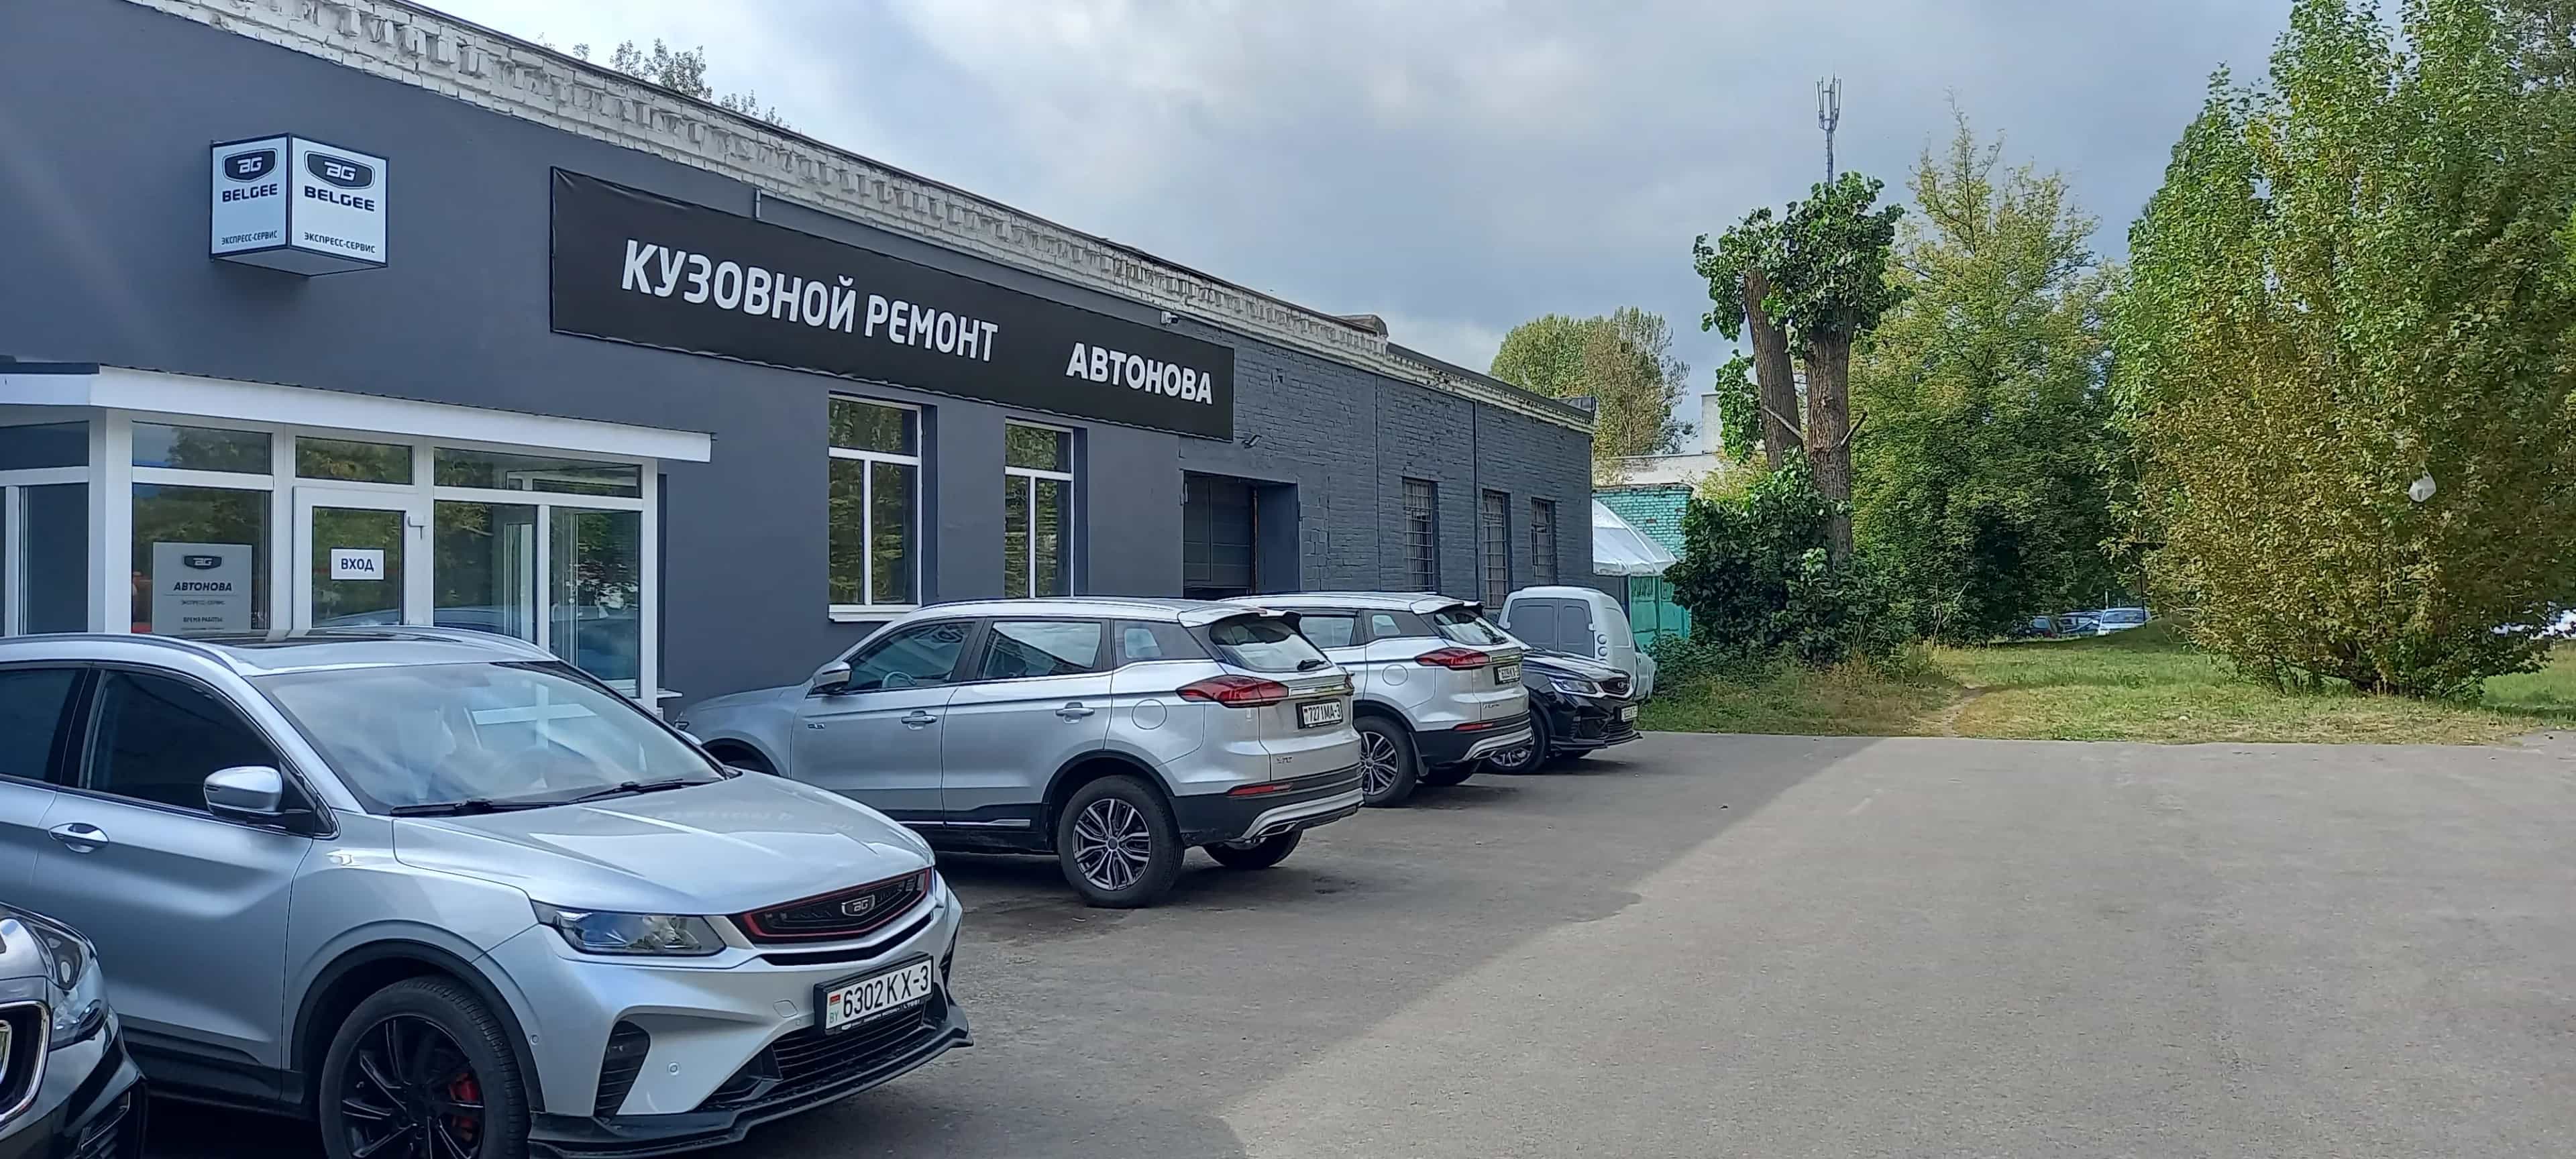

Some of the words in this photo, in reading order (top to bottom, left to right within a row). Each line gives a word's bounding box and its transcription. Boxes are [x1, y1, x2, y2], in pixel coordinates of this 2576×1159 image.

[222, 183, 278, 203] BELGEE
[304, 184, 375, 212] BELGEE
[221, 230, 278, 245] ЭКСПРЕСС-СЕРВИС
[304, 231, 376, 254] ЭКСПРЕСС-СЕРВИС
[621, 238, 858, 333] КУЗОВНОЙ
[864, 293, 998, 363] РЕМОНТ
[1066, 342, 1213, 405] АВТОНОВА
[341, 558, 374, 571] ВХОД
[173, 582, 232, 591] АВТОНОВА
